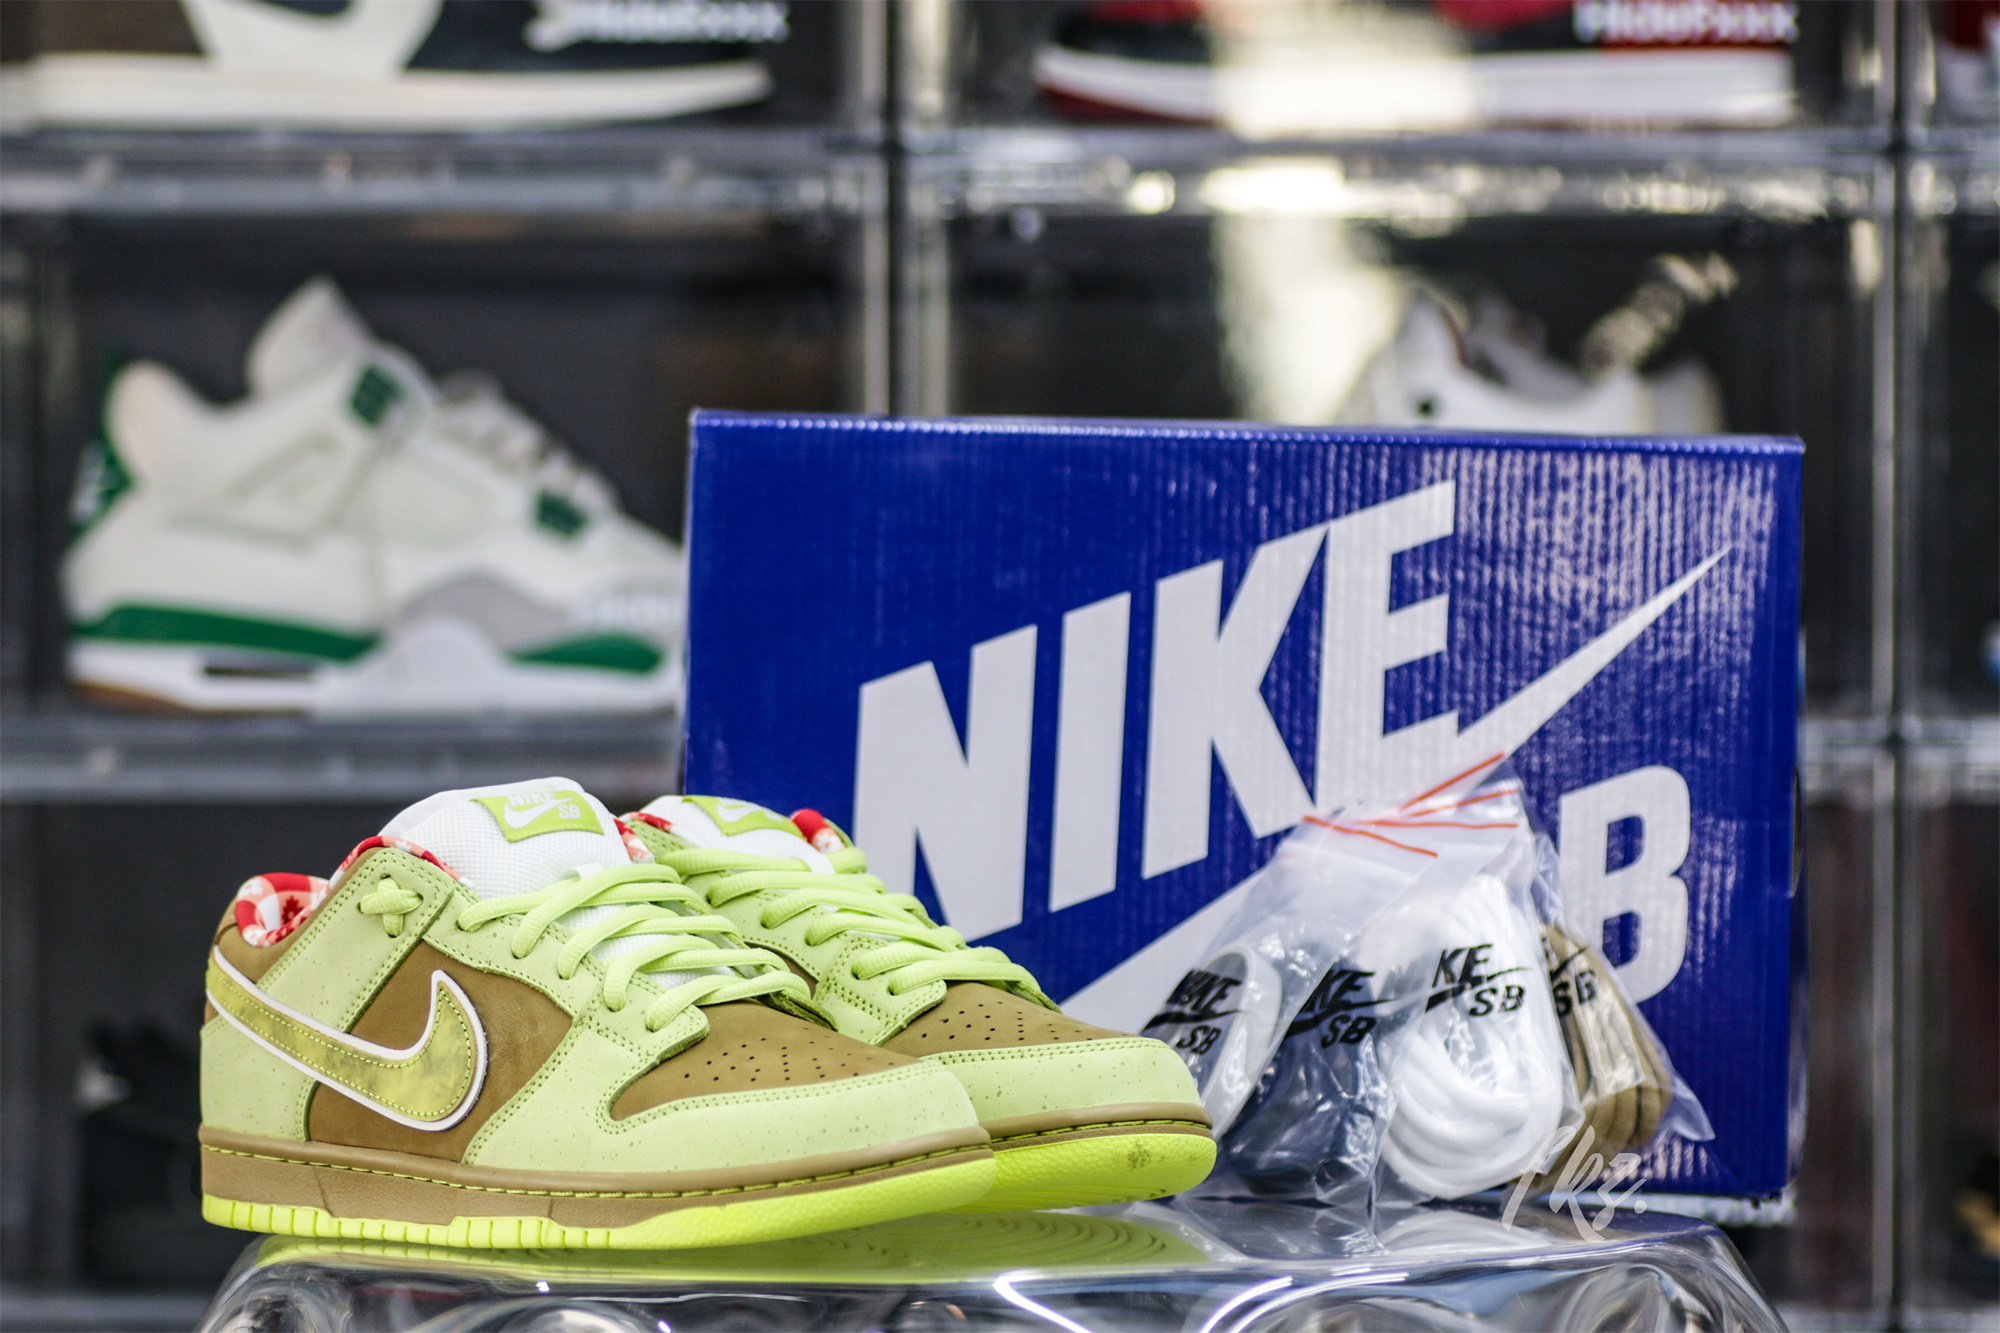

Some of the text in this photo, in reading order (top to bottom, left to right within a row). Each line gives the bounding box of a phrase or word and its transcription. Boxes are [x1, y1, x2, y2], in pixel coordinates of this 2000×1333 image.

[853, 480, 1459, 942] NIKE
[507, 791, 556, 807] NIKE
[558, 804, 582, 819] SB
[1431, 943, 1493, 988] KE
[1468, 984, 1526, 1017] SB
[1175, 1025, 1222, 1055] SB
[1321, 1014, 1378, 1048] SB
